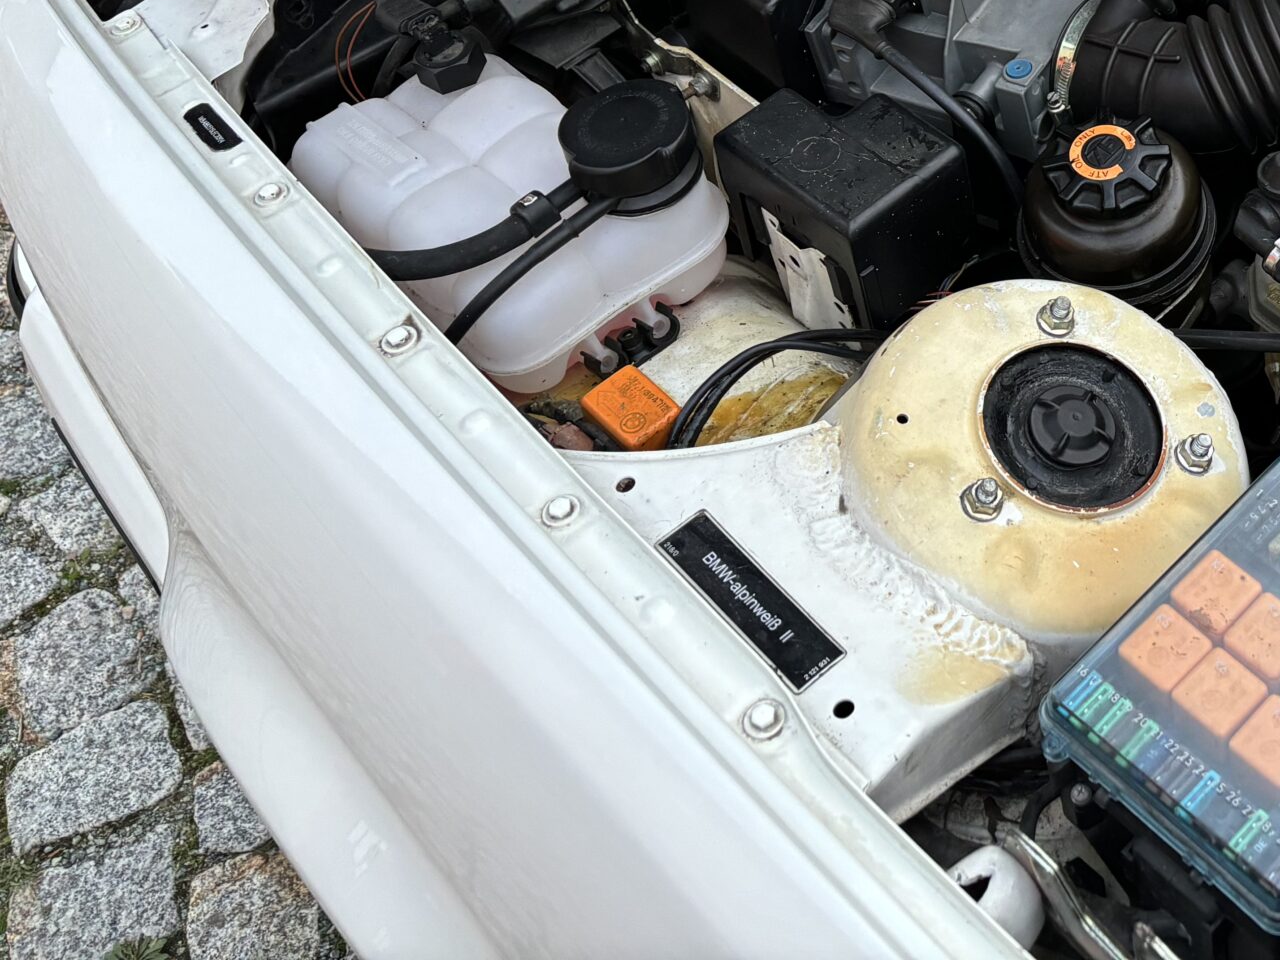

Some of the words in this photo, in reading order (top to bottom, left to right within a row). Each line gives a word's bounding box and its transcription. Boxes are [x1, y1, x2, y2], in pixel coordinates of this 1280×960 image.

[1074, 128, 1096, 147] ONLY
[1087, 169, 1109, 178] ATF
[701, 551, 782, 632] BMW-alpinweiß
[779, 628, 795, 644] II
[1076, 664, 1089, 677] 16
[1163, 738, 1179, 753] 22
[1176, 749, 1195, 767] 23
[1225, 790, 1242, 806] 26
